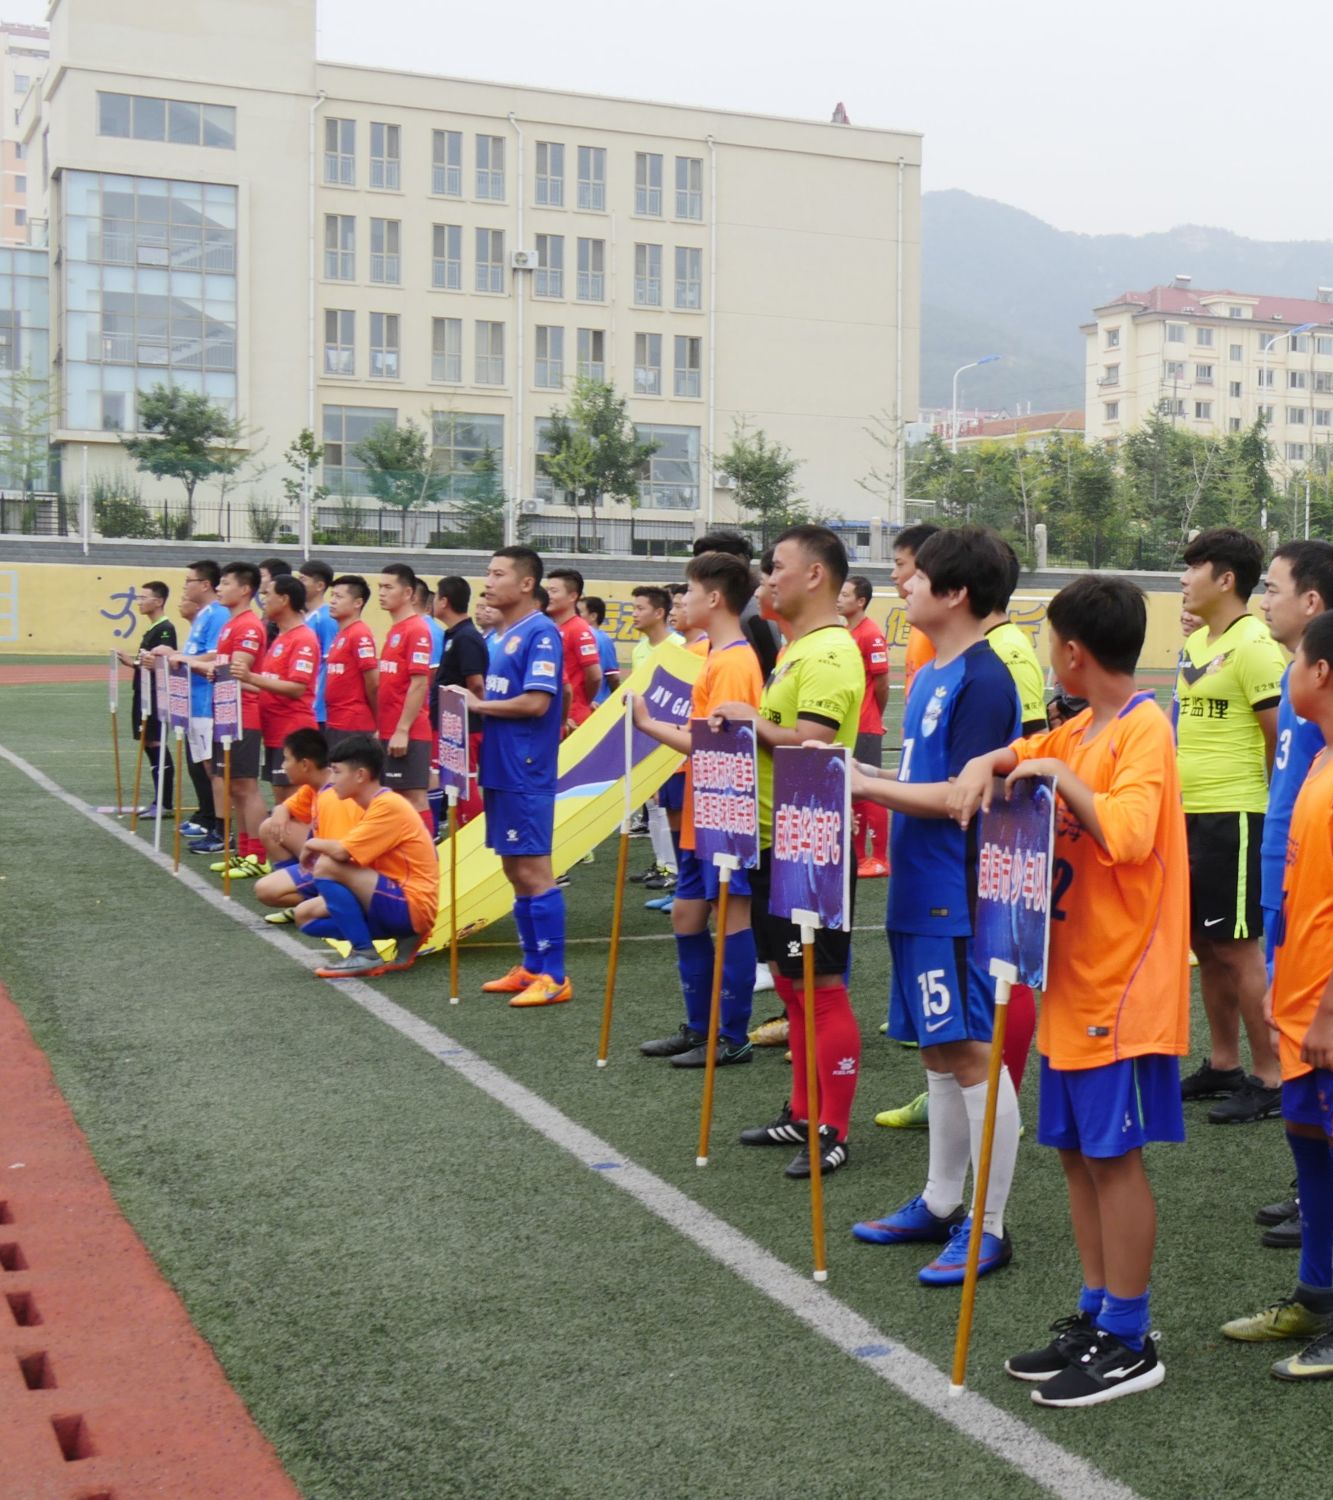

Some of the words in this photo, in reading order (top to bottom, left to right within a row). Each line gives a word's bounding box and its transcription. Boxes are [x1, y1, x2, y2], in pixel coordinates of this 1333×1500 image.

[978, 841, 1048, 914] 威海市少年队
[917, 969, 951, 1017] 15
